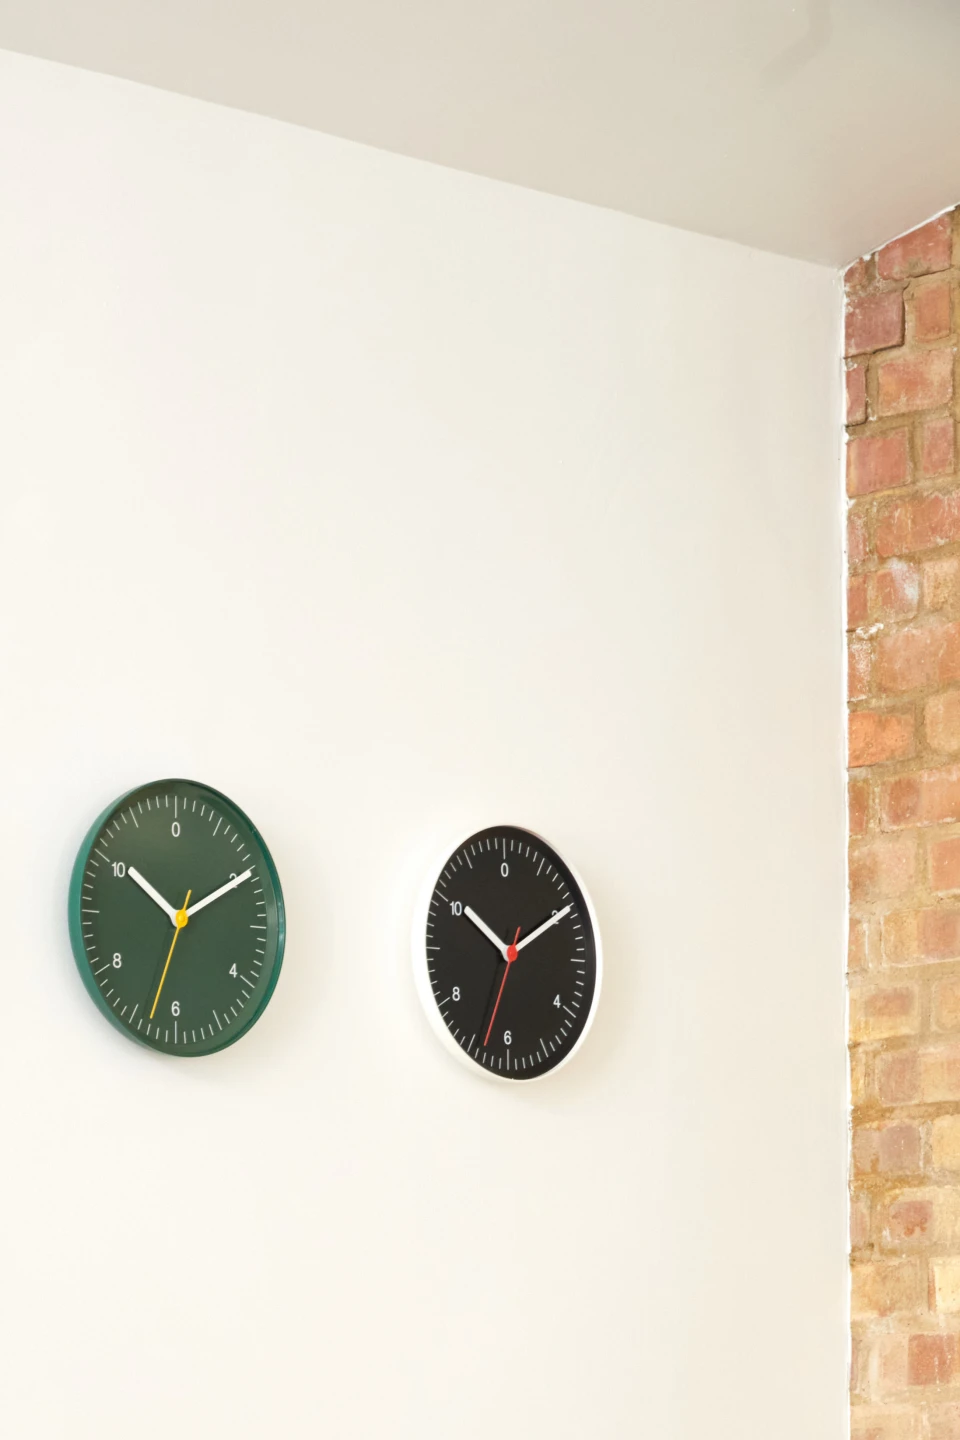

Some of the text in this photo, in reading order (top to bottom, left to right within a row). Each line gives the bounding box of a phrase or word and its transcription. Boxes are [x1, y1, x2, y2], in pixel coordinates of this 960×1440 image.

[171, 821, 181, 838] 0
[111, 861, 126, 878] 10
[500, 862, 509, 878] 0
[449, 900, 463, 917] 10
[112, 952, 122, 969] 8
[228, 962, 238, 979] 4
[451, 986, 461, 1002] 8
[552, 994, 561, 1009] 4
[171, 1000, 181, 1017] 6
[503, 1030, 512, 1046] 6
